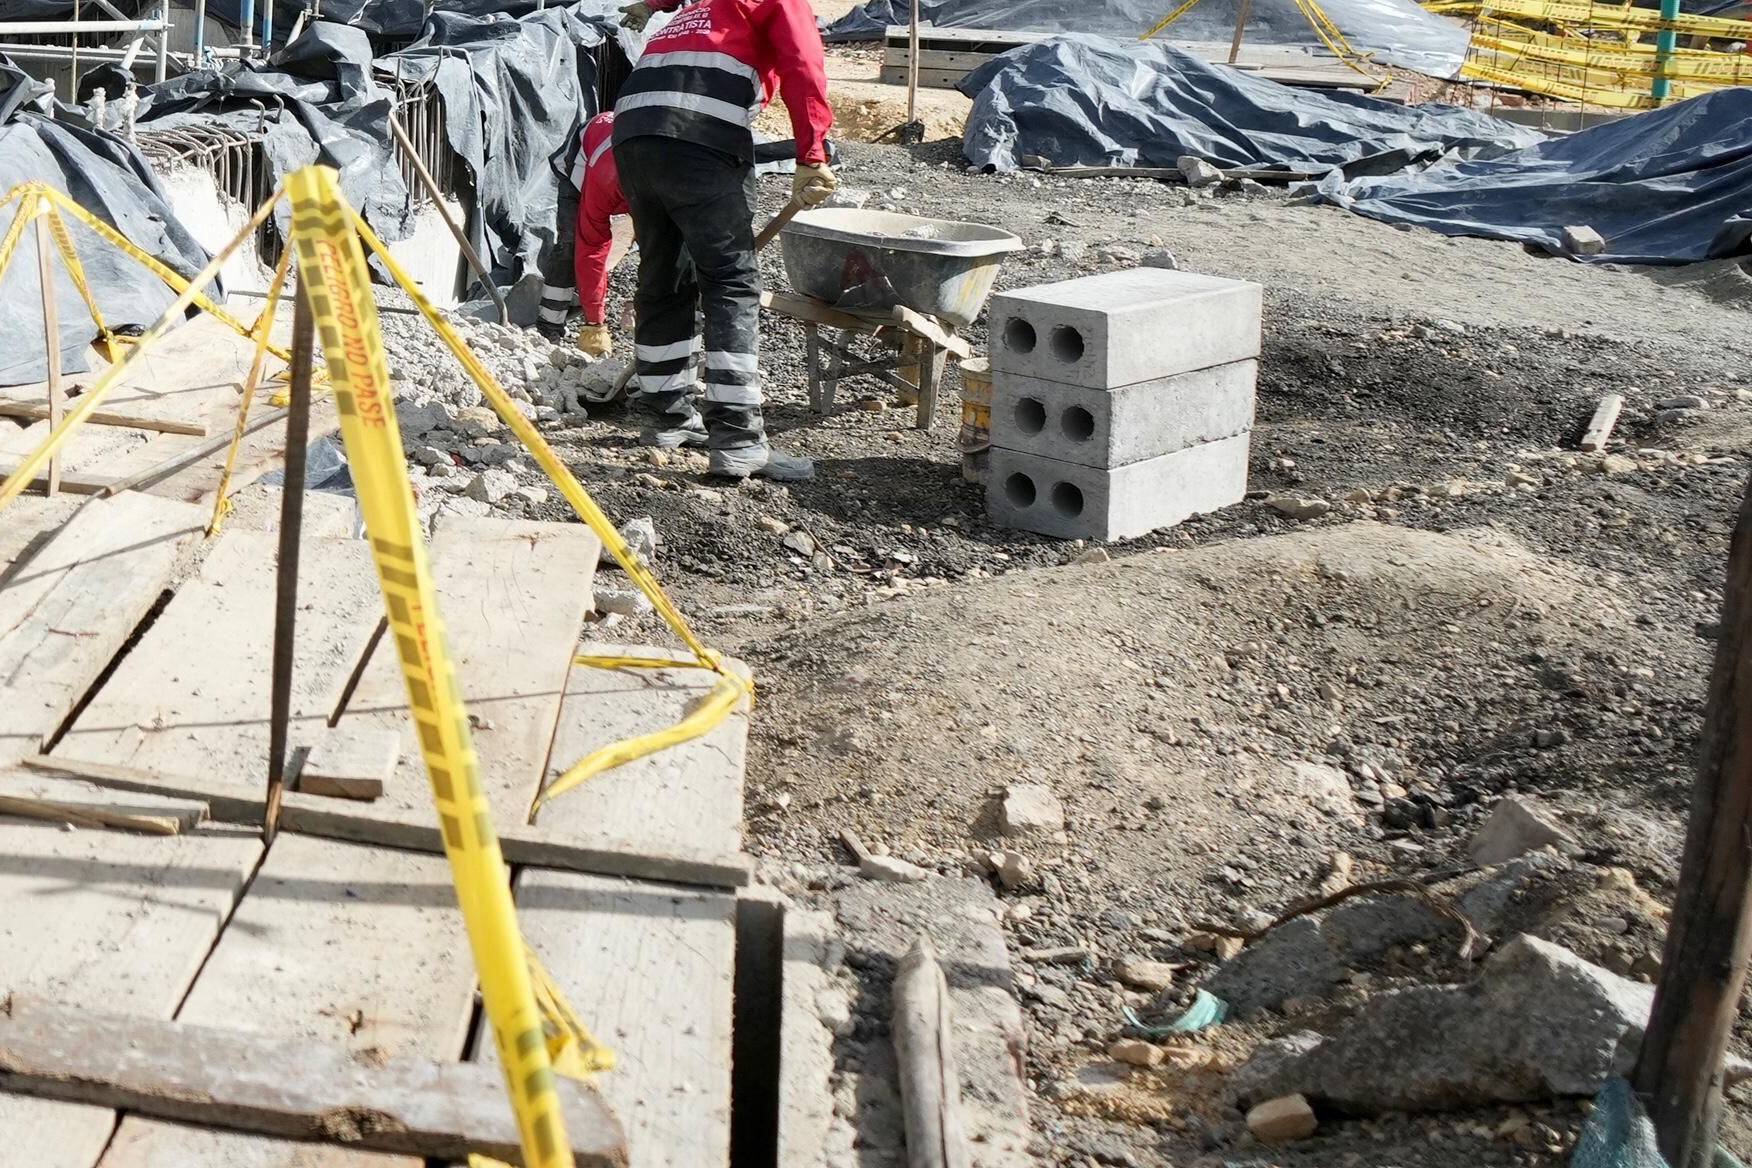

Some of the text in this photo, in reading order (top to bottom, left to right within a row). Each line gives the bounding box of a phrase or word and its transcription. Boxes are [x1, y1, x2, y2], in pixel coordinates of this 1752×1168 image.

[316, 240, 386, 428] PELIGRO NO PASE
